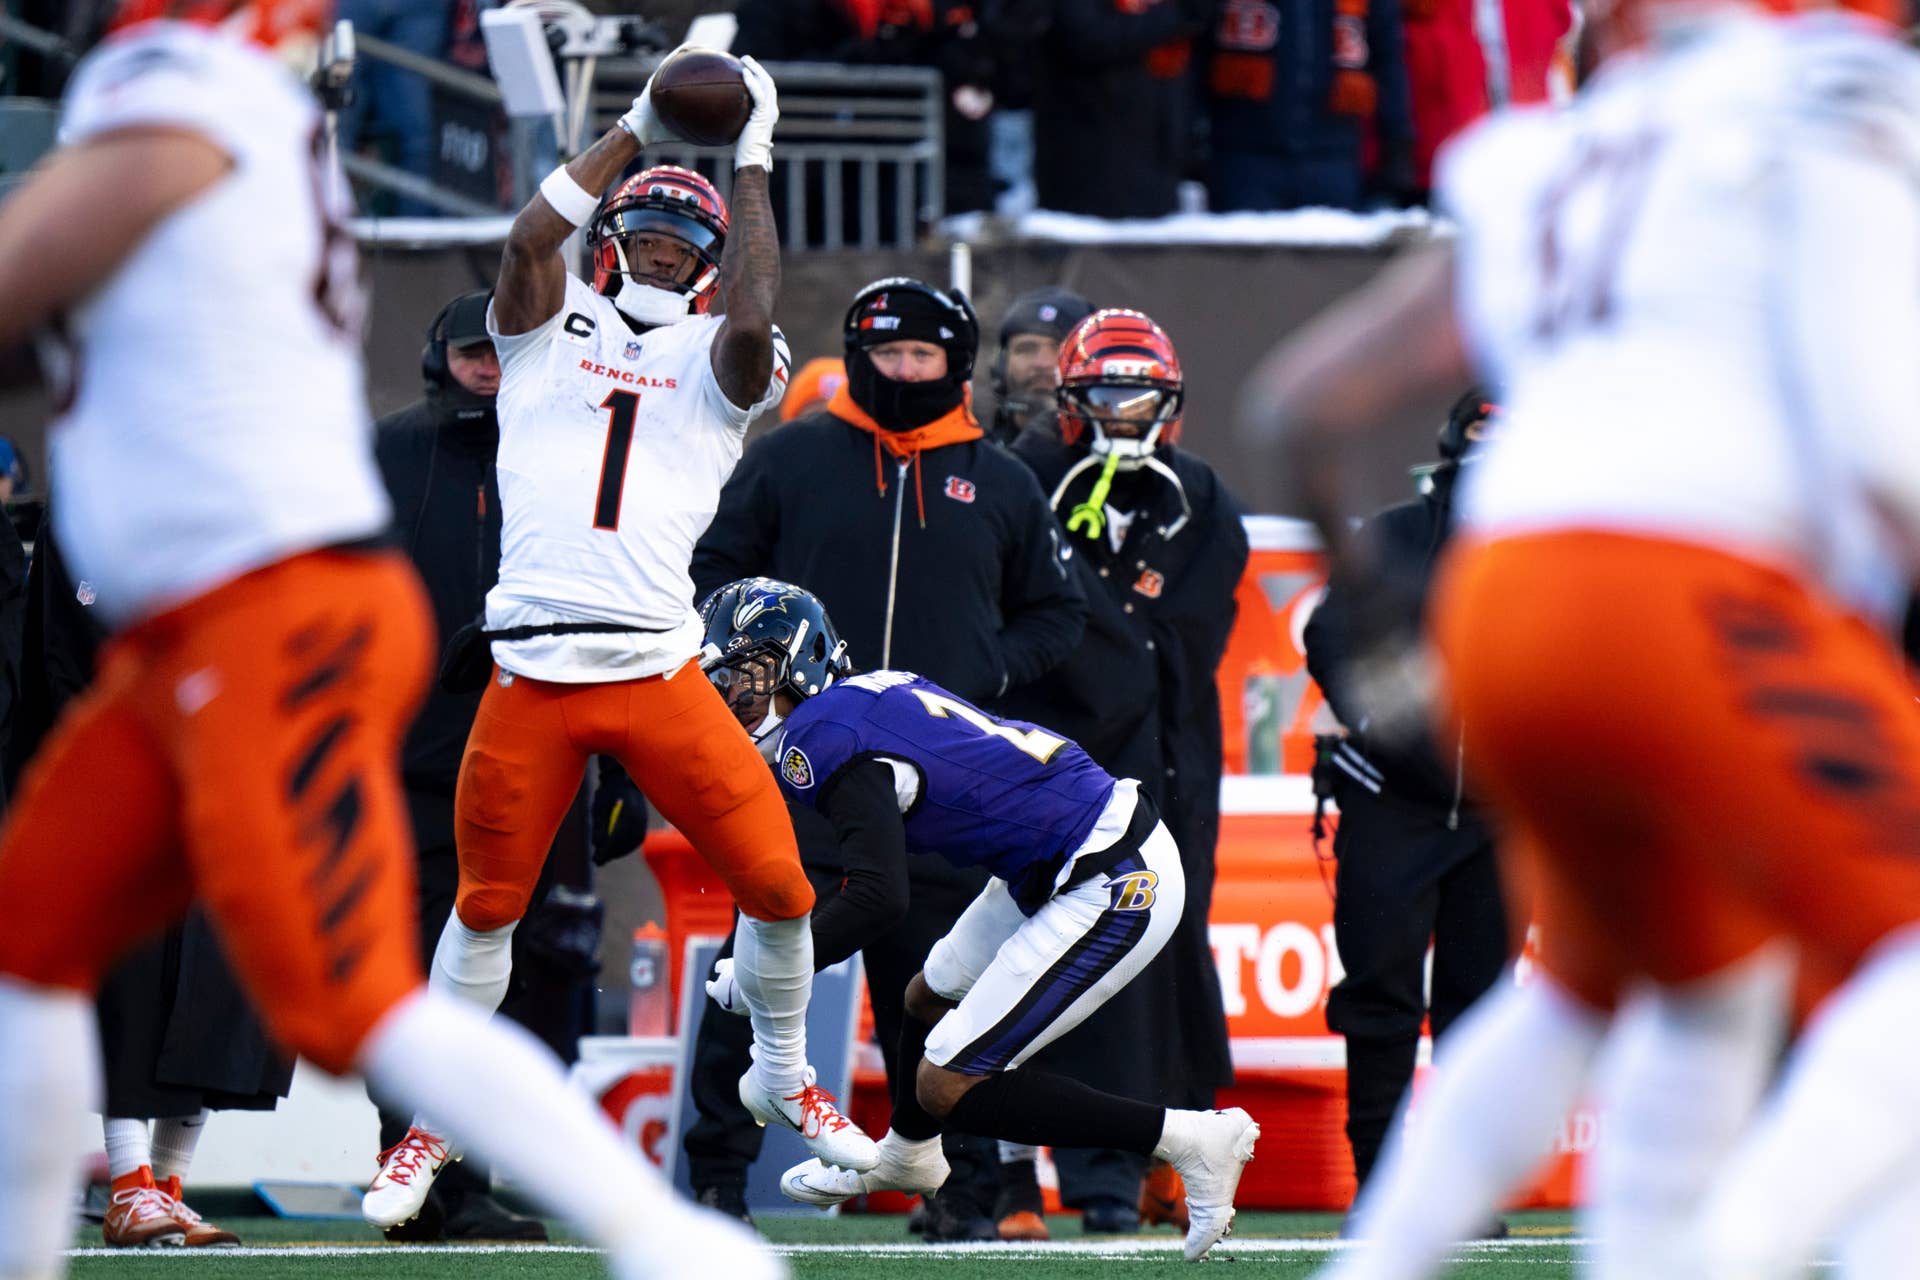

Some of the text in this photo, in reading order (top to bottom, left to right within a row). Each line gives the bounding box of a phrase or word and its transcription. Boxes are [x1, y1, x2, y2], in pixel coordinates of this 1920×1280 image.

[564, 312, 596, 338] C
[579, 359, 678, 389] BENGALS
[592, 387, 642, 532] 1
[911, 688, 1067, 766] 2
[1101, 869, 1160, 912] B
[1207, 922, 1348, 1019] TO
